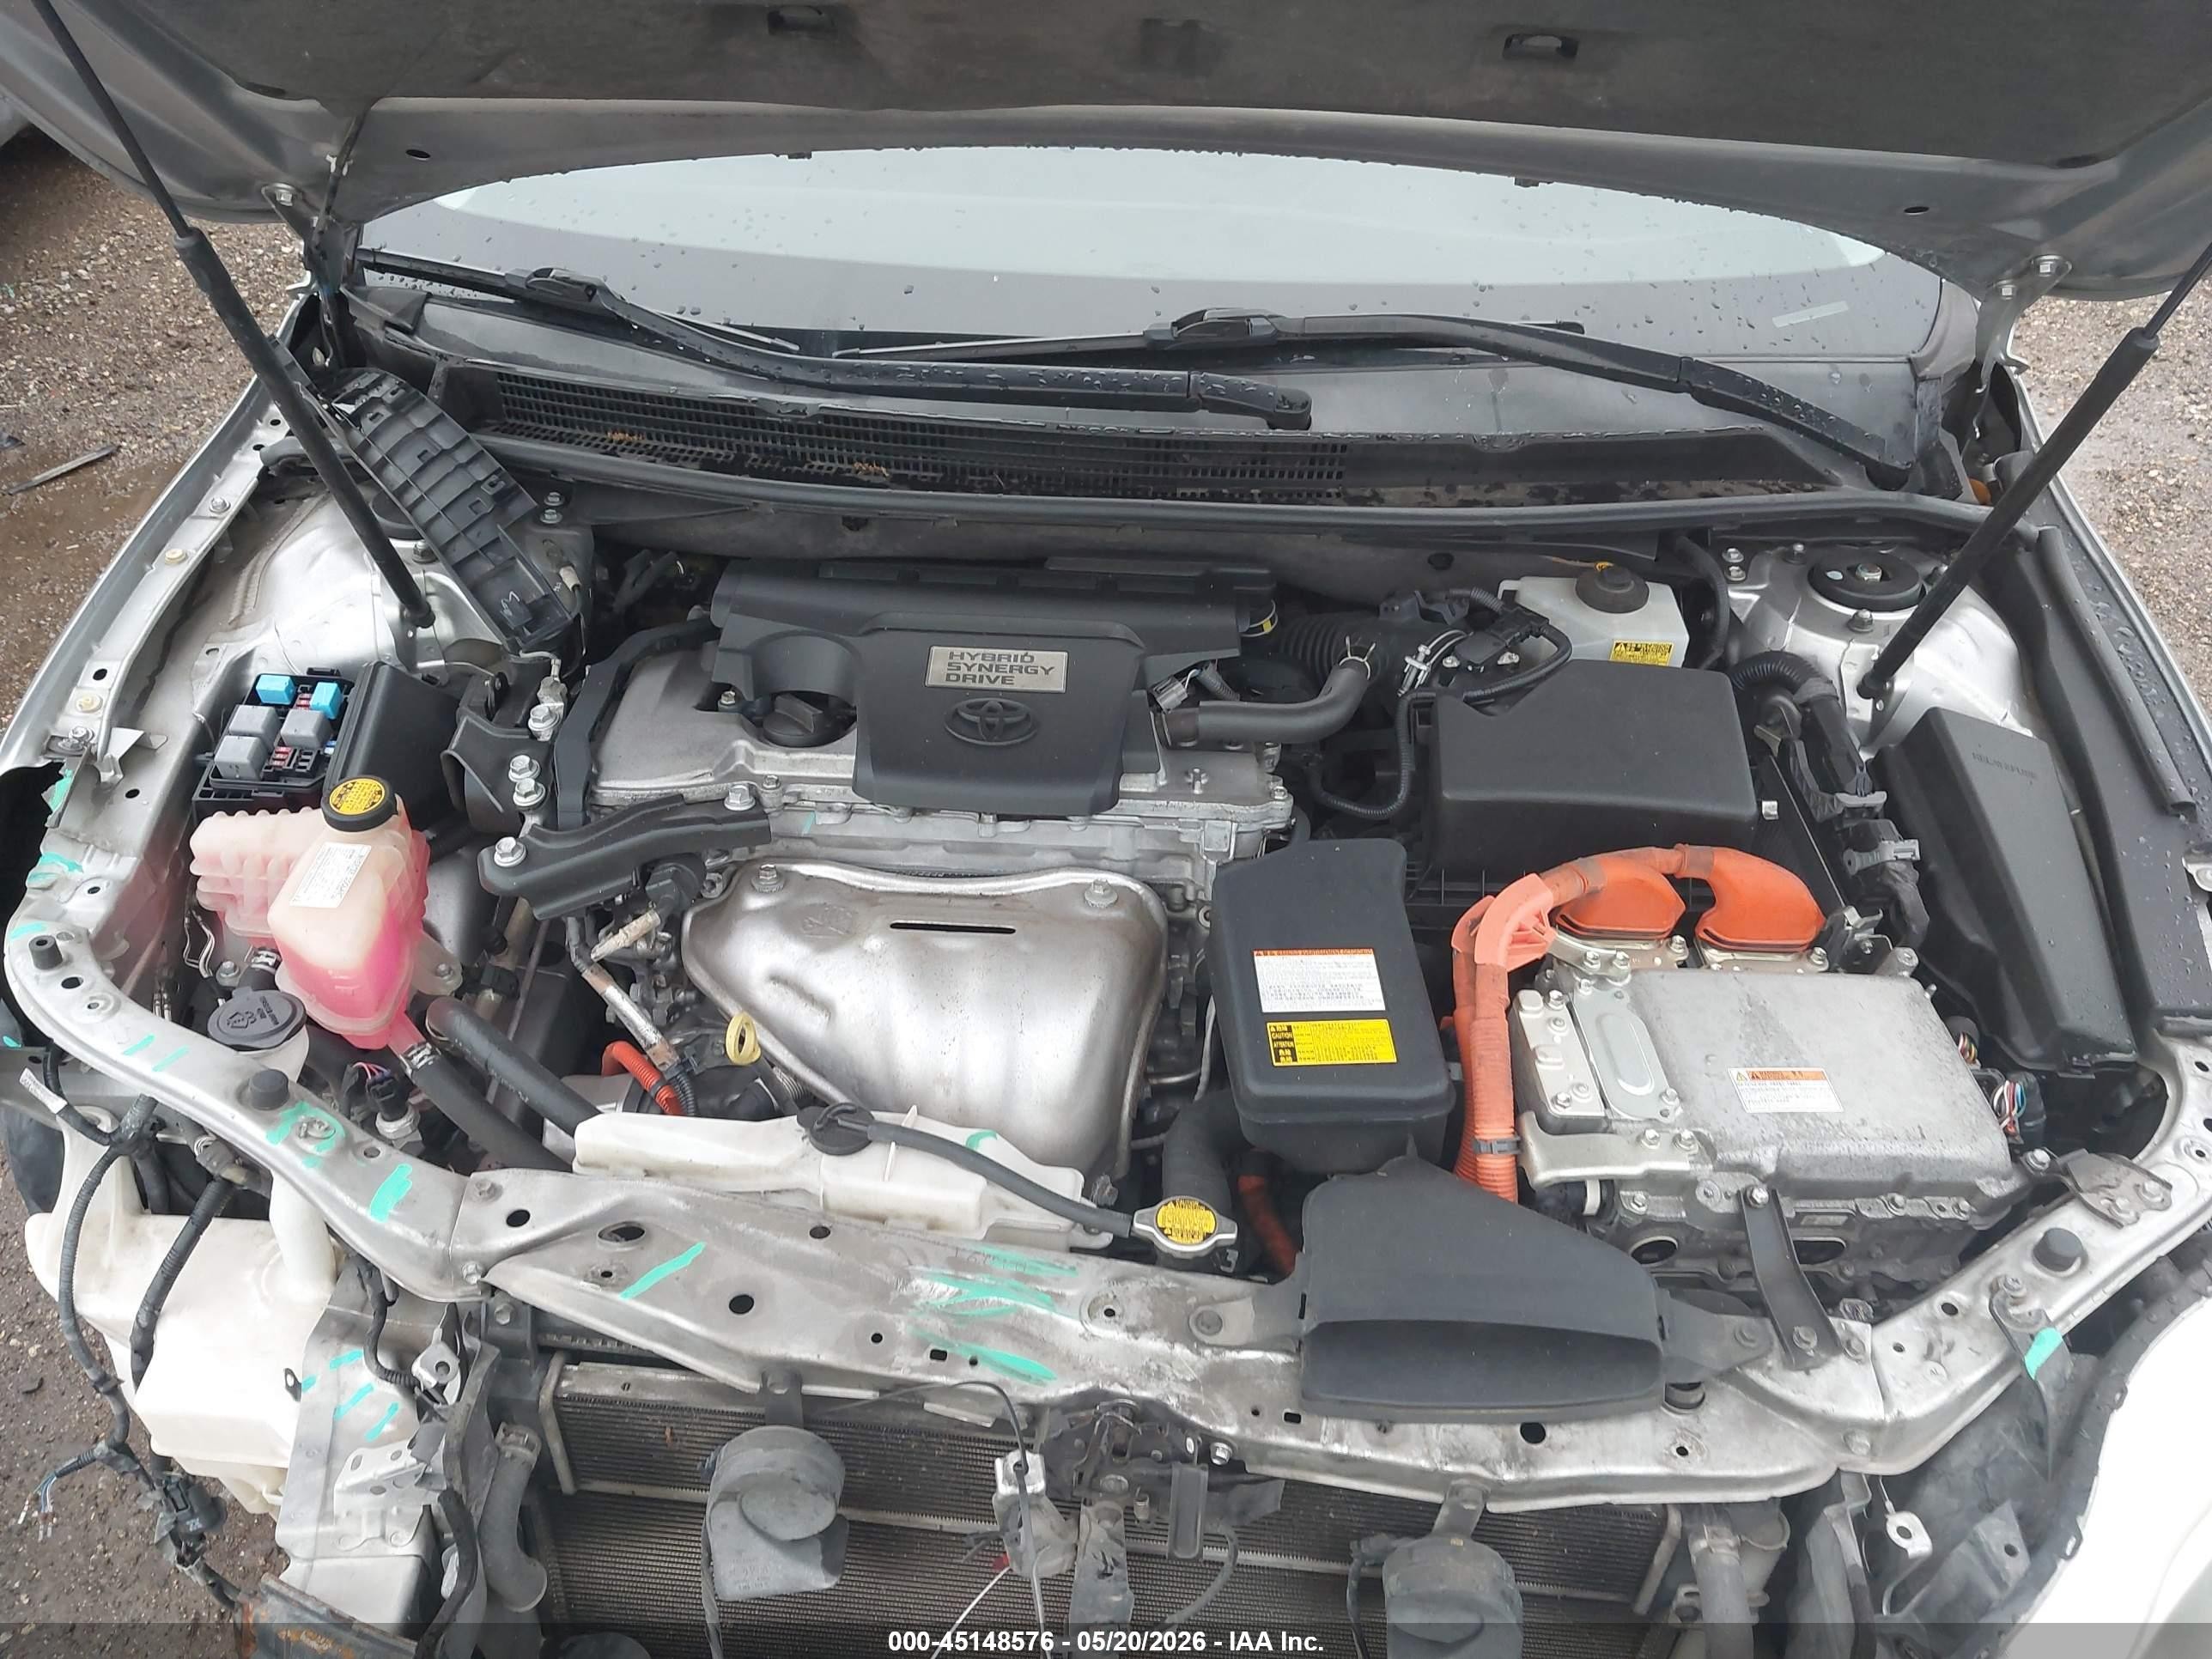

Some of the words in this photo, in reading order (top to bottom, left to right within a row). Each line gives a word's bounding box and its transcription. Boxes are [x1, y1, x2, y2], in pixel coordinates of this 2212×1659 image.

[948, 652, 1035, 663] HYBRID
[946, 662, 1055, 676] SYNERGY
[945, 673, 1015, 685] DRIVE
